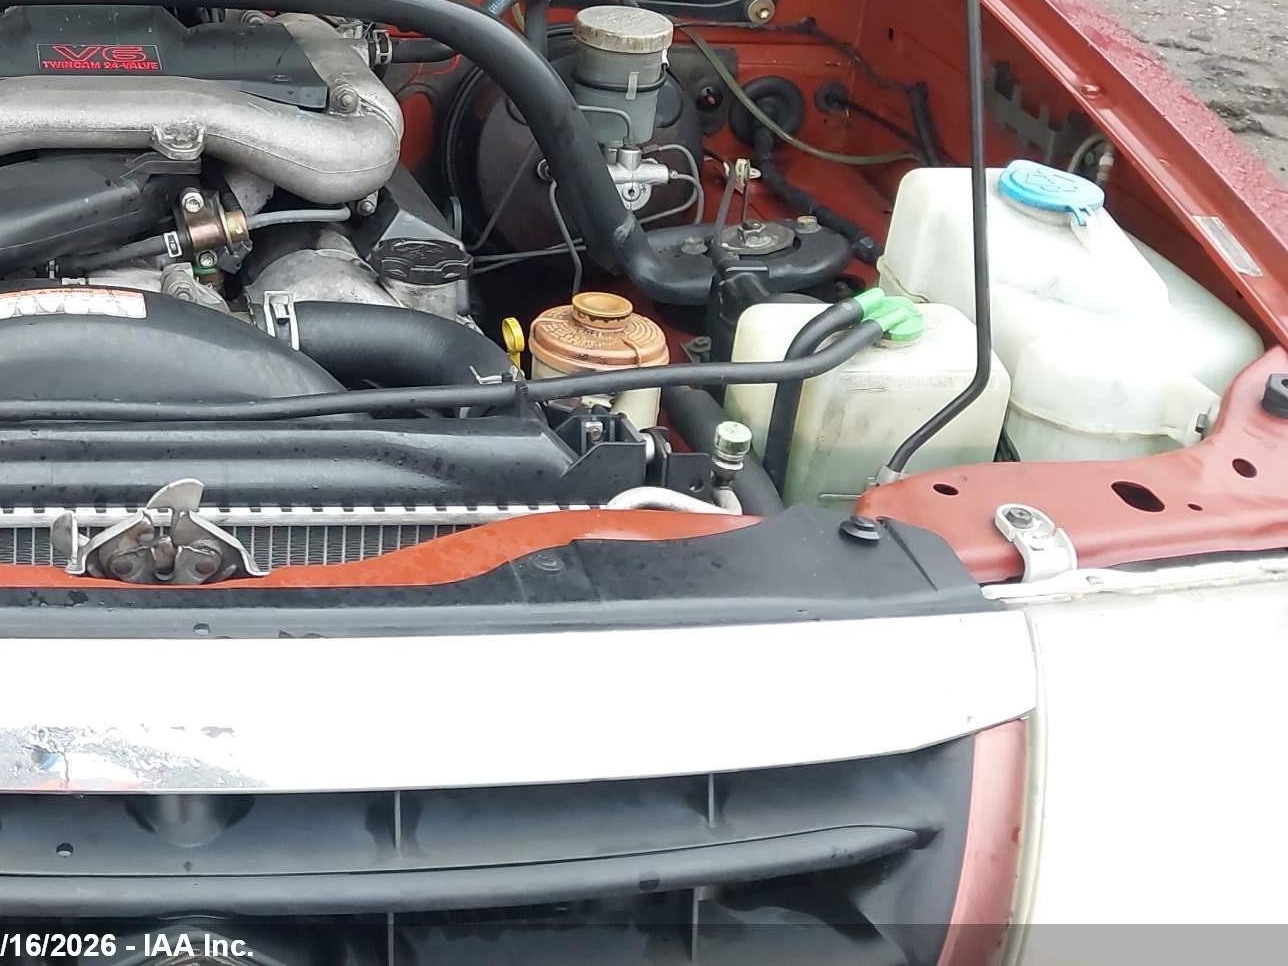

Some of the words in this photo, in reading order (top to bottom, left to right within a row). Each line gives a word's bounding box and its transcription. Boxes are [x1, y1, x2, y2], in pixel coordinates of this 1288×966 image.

[52, 45, 147, 62] V6
[41, 61, 101, 69] TWINCAM
[103, 62, 160, 70] 24-VALVE
